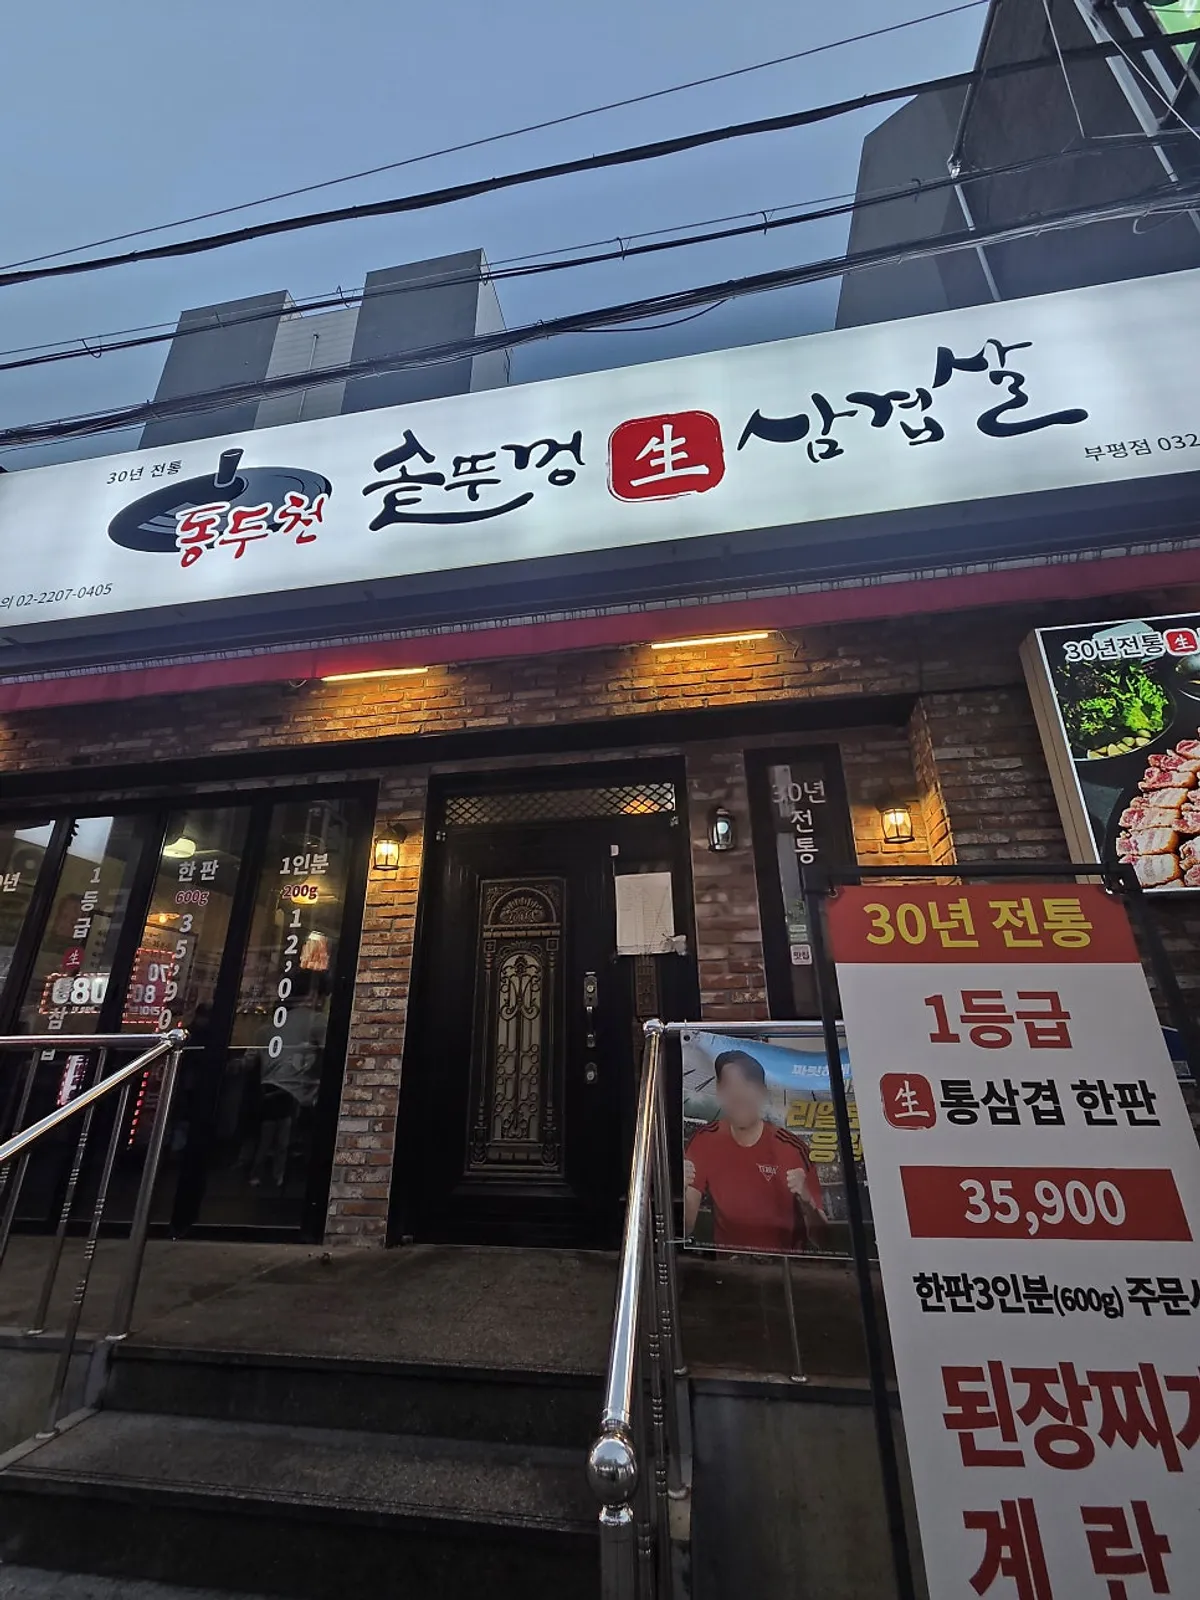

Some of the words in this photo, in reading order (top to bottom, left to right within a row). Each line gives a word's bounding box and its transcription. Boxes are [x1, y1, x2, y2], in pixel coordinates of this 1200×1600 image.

[362, 429, 586, 531] 솥뚜껑
[629, 423, 710, 487] 生
[737, 338, 1088, 463] 삼겹살
[1084, 438, 1152, 462] 부평점
[1157, 433, 1200, 451] 032
[106, 467, 144, 485] 30년
[150, 460, 182, 478] 전통
[178, 494, 325, 568] 동두천
[16, 582, 113, 607] 02-2207-0405
[1174, 633, 1195, 651] 生
[772, 780, 826, 803] 30년
[791, 809, 819, 864] 전통
[279, 853, 330, 875] 1인분
[175, 889, 209, 906] 600g
[283, 884, 319, 900] 200g
[863, 898, 979, 948] 30년
[989, 897, 1093, 948] 전통
[159, 914, 194, 1029] 35,90
[924, 989, 1073, 1049] 1등급
[894, 1079, 931, 1119] 生
[940, 1079, 1066, 1126] 통삼겹
[1071, 1079, 1161, 1126] 한판
[959, 1178, 1126, 1236] 35,900
